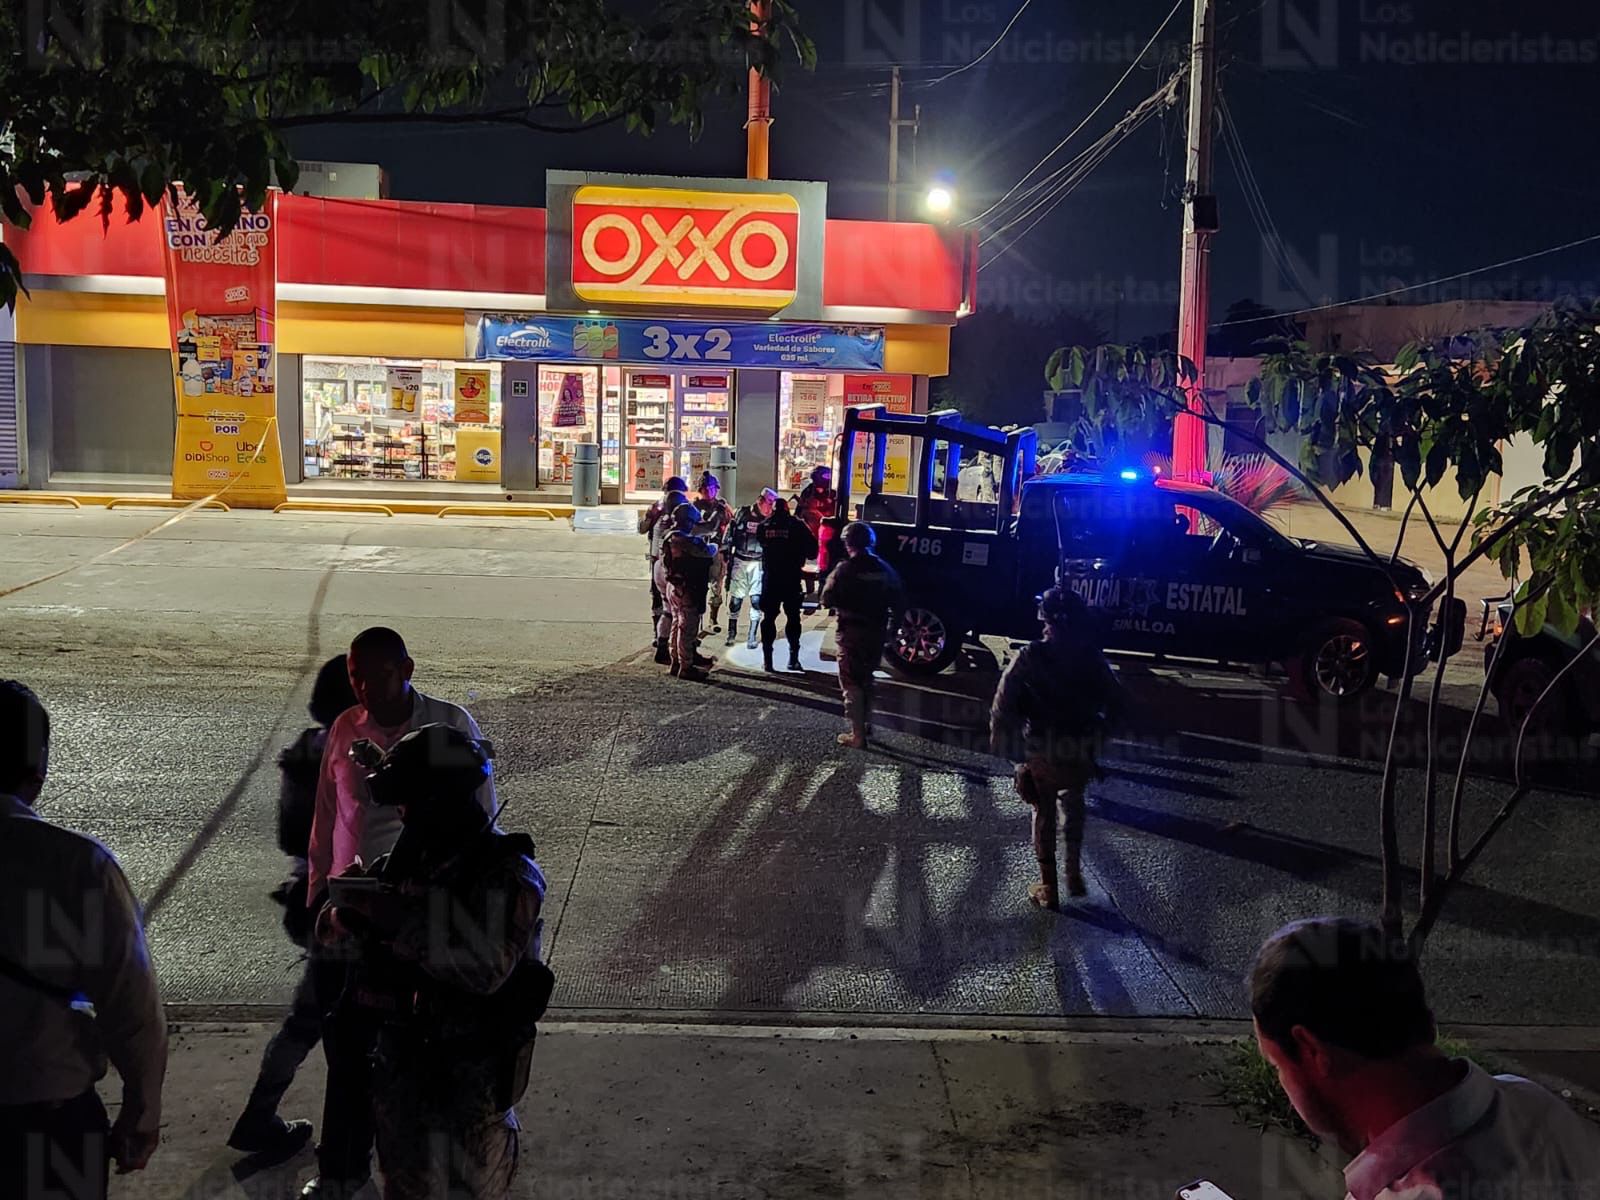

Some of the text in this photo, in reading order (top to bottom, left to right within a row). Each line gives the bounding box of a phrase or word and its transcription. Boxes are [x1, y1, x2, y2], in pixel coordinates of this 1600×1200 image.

[167, 218, 191, 232] EN
[172, 234, 206, 247] CON
[581, 209, 789, 286] OXXO
[183, 247, 258, 263] necesitas
[496, 335, 550, 348] Electrolit
[643, 326, 731, 360] 3x2
[753, 343, 836, 353] Variedad de Sabores
[215, 425, 238, 434] POR
[896, 534, 943, 557] 7186
[1166, 582, 1248, 616] ESTATAL
[1112, 618, 1177, 635] SINALOA
